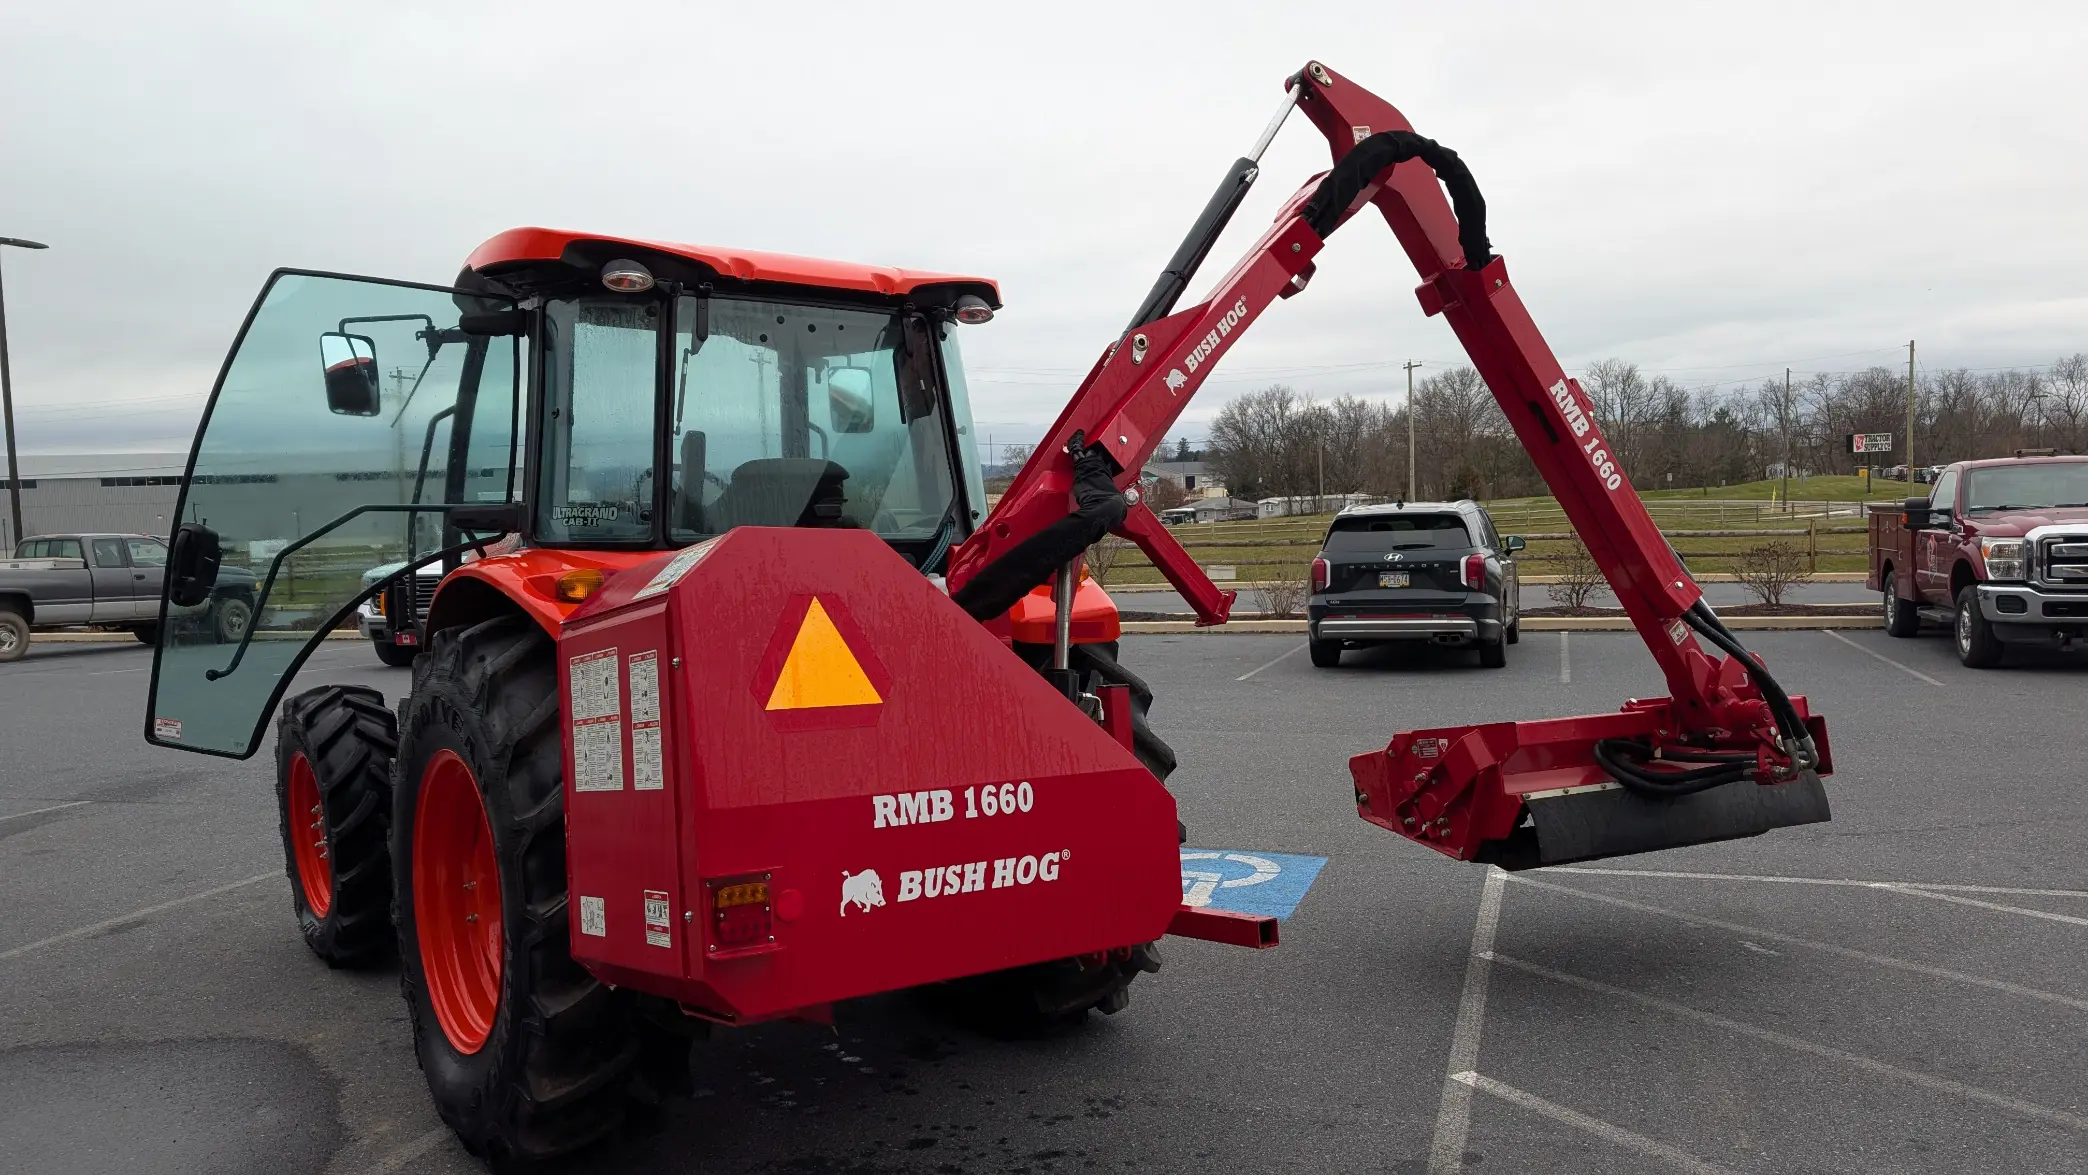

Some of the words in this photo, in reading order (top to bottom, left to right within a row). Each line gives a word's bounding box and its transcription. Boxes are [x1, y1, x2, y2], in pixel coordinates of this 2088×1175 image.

[1184, 328, 1221, 374] BUSH
[1549, 378, 1590, 438] RMB
[1583, 437, 1621, 491] 1660
[1864, 434, 1891, 443] TRACTOR
[552, 505, 618, 521] ULTRAGRAND
[872, 789, 954, 829] RMB
[964, 781, 1034, 819] 1660
[897, 861, 987, 903] BUSH
